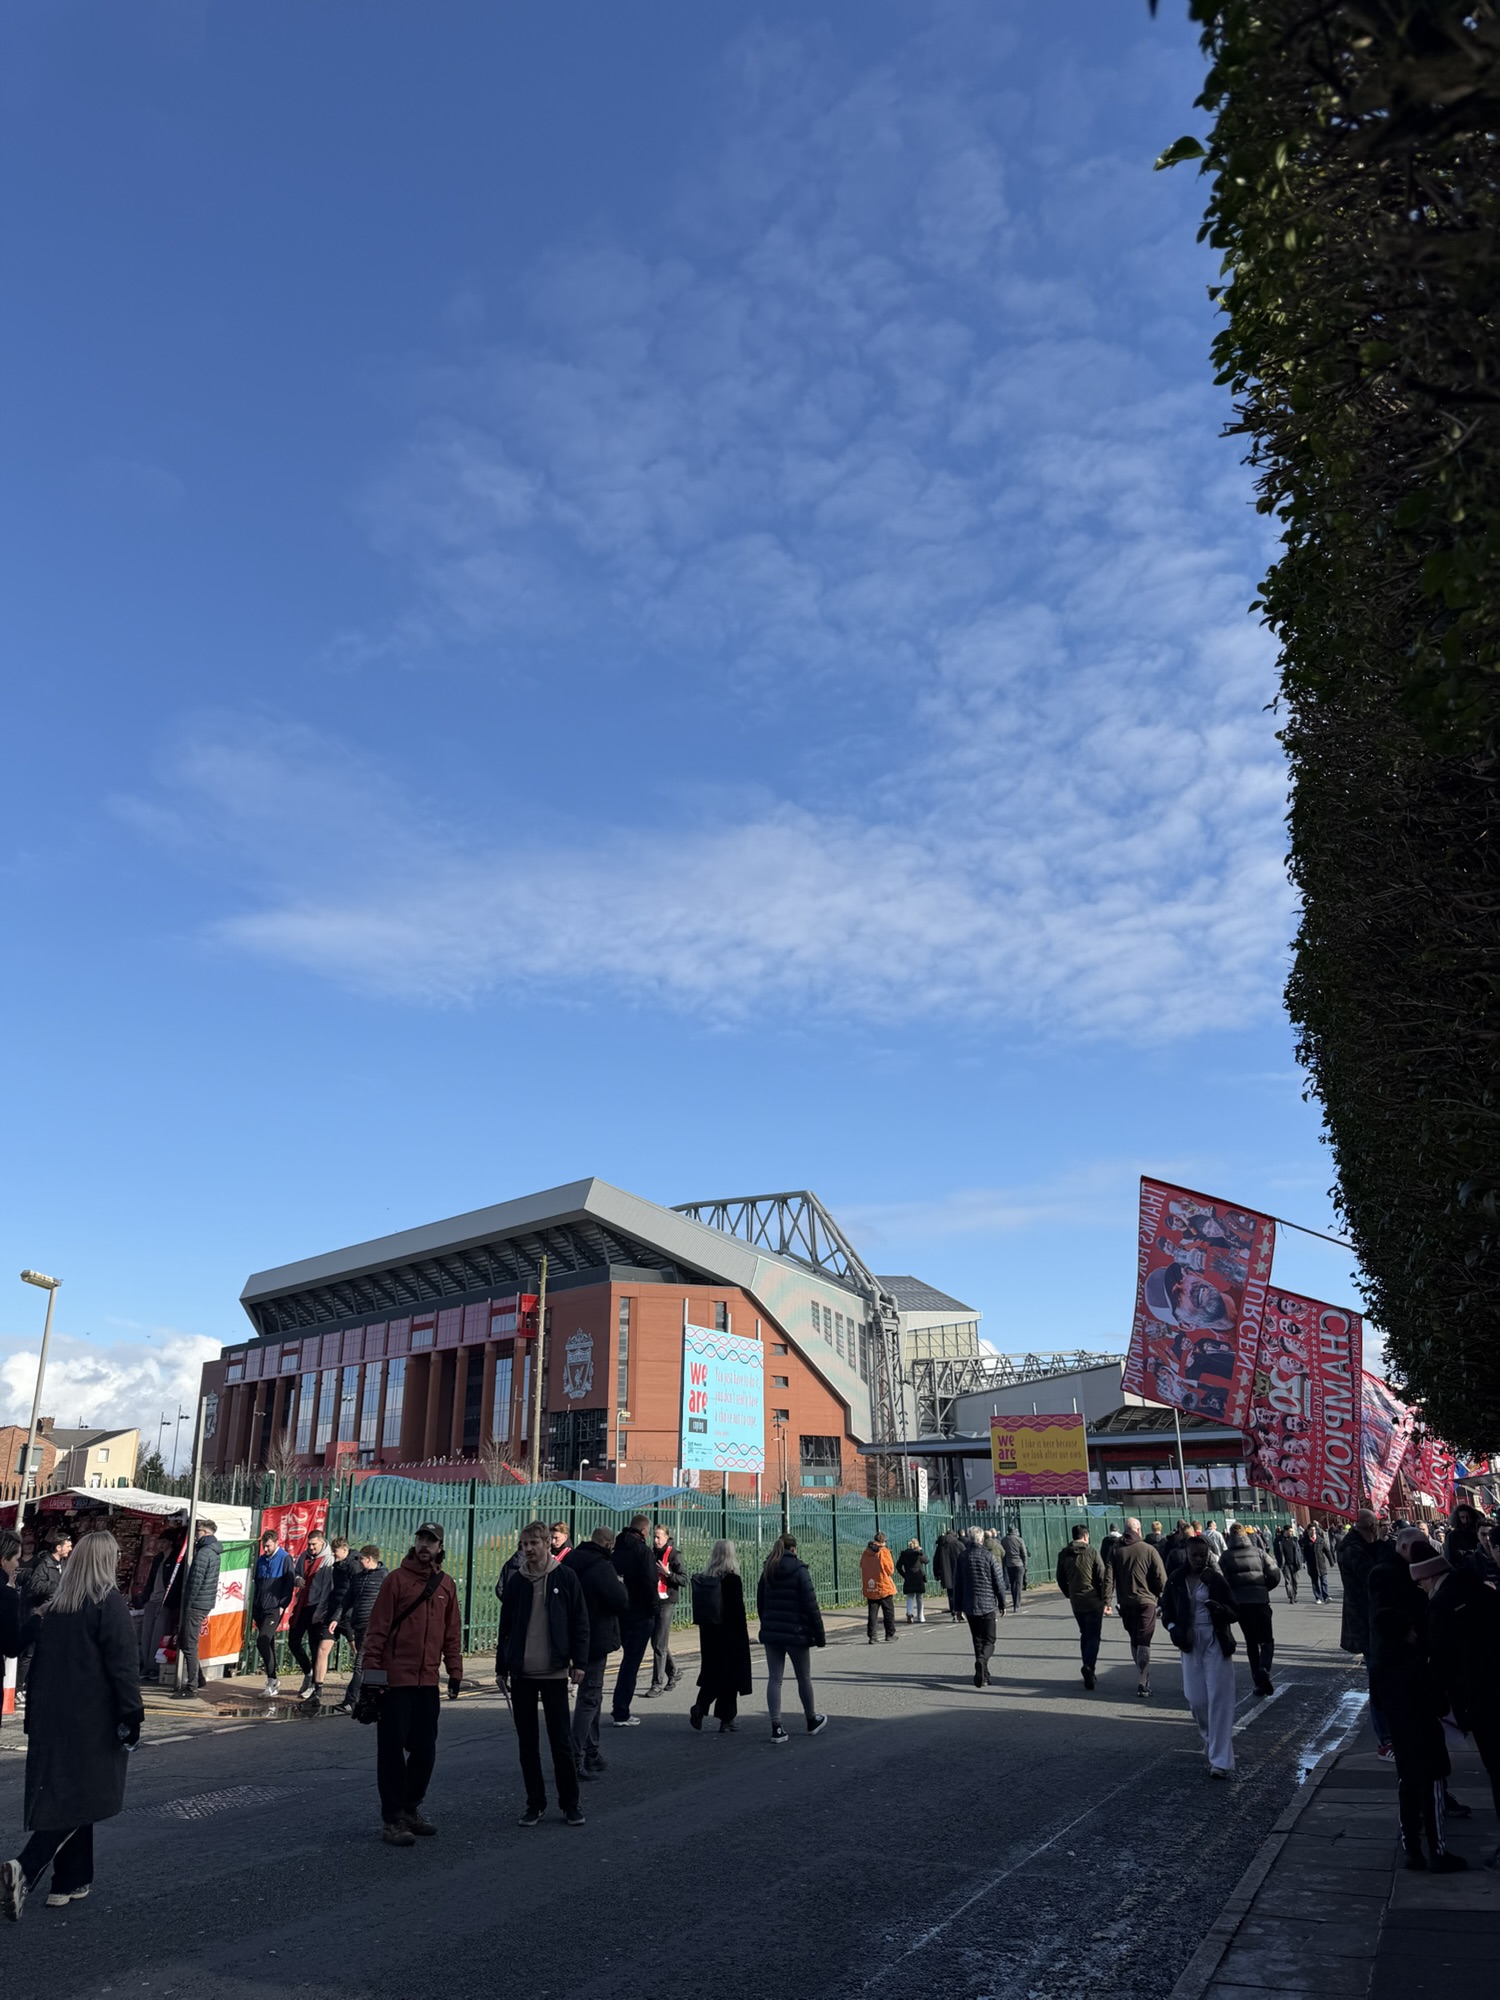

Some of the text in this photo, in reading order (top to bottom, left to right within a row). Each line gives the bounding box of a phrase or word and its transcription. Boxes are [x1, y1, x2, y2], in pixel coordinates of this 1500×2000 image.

[690, 1362, 708, 1387] we
[689, 1390, 708, 1414] are
[998, 1435, 1014, 1446] we
[998, 1449, 1016, 1460] are
[287, 1511, 308, 1540] 20
